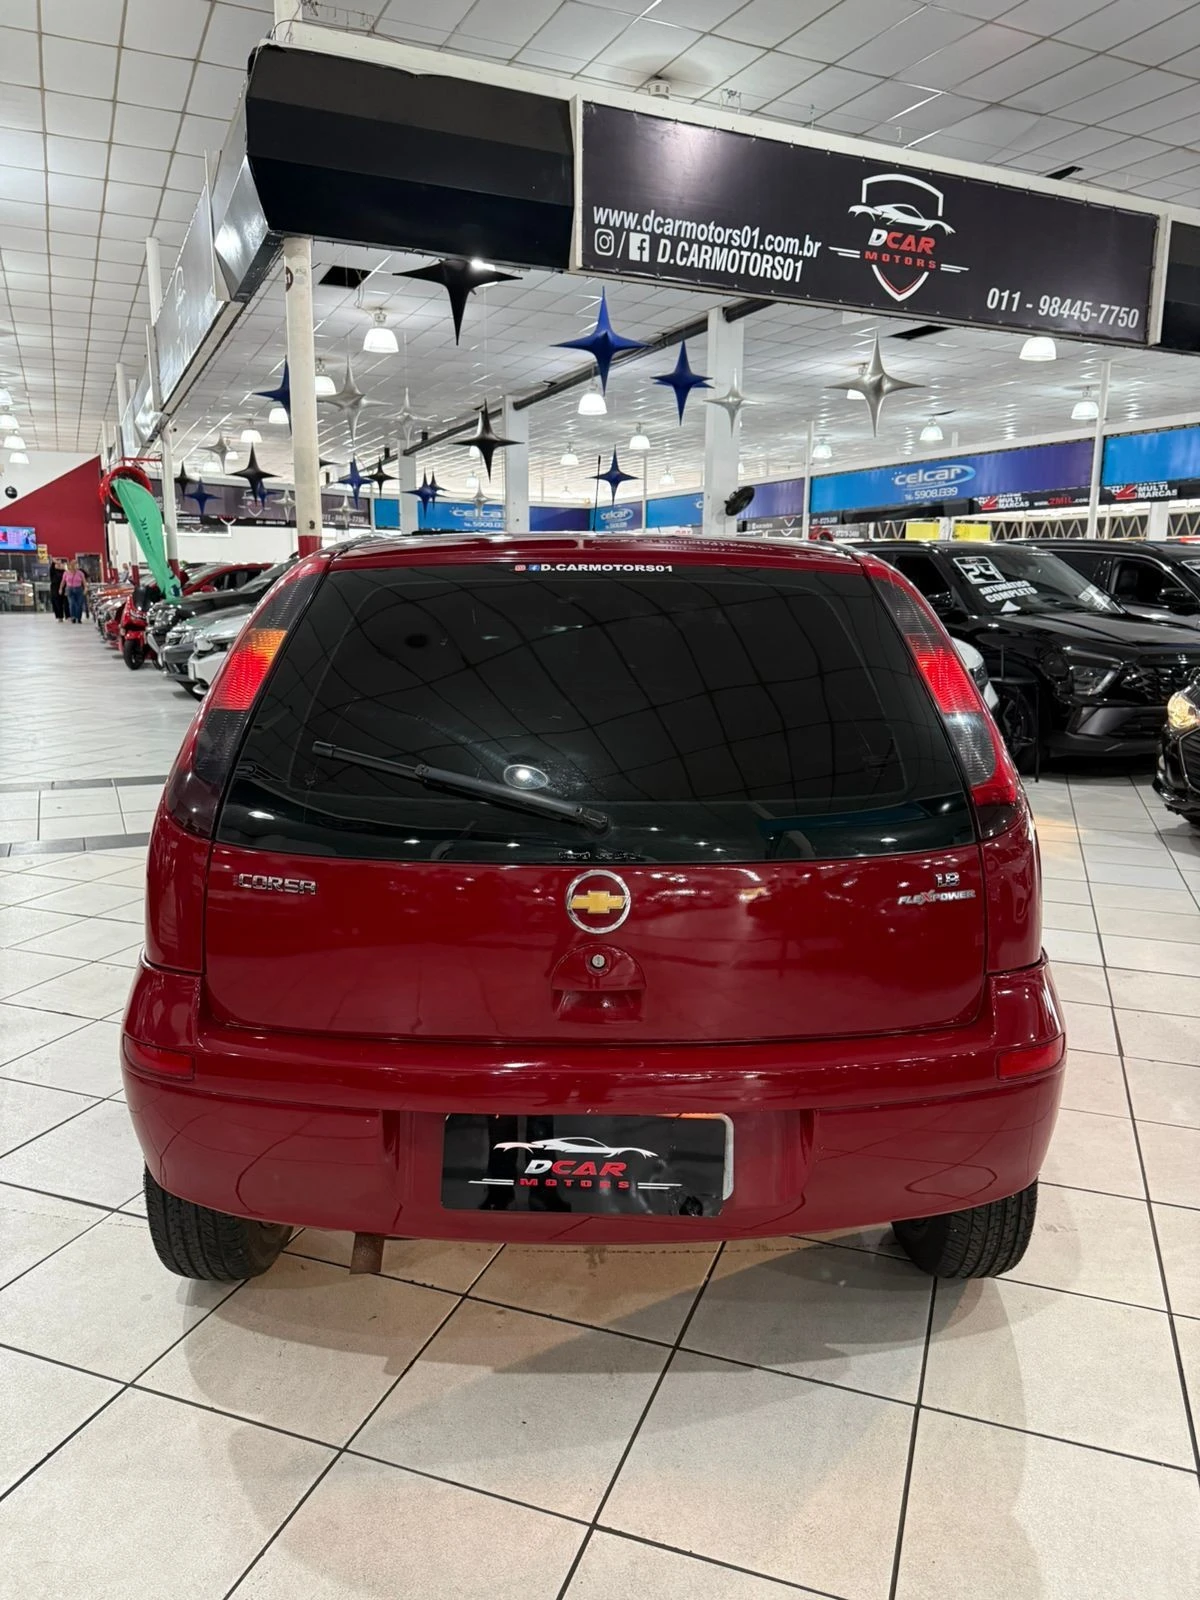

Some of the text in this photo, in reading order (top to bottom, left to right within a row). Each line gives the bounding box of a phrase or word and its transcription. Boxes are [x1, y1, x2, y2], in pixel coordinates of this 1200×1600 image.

[593, 205, 822, 258] www.dcarmotors01.com.br
[868, 228, 936, 255] DCAR
[657, 238, 804, 283] D.CARMOTORS01
[864, 250, 937, 270] MOTORS
[986, 287, 1021, 312] 011
[1038, 294, 1140, 328] 98445-7750
[894, 467, 962, 486] celcar
[1137, 483, 1169, 492] MULTI
[1137, 489, 1178, 499] MARCAS
[999, 501, 1030, 510] MARCAS
[540, 563, 673, 572] D.CARMOTORS01
[984, 586, 1039, 604] COMPLETO
[238, 873, 316, 895] CORSA
[524, 1159, 628, 1177] DCAR
[519, 1177, 630, 1189] MOTORS
